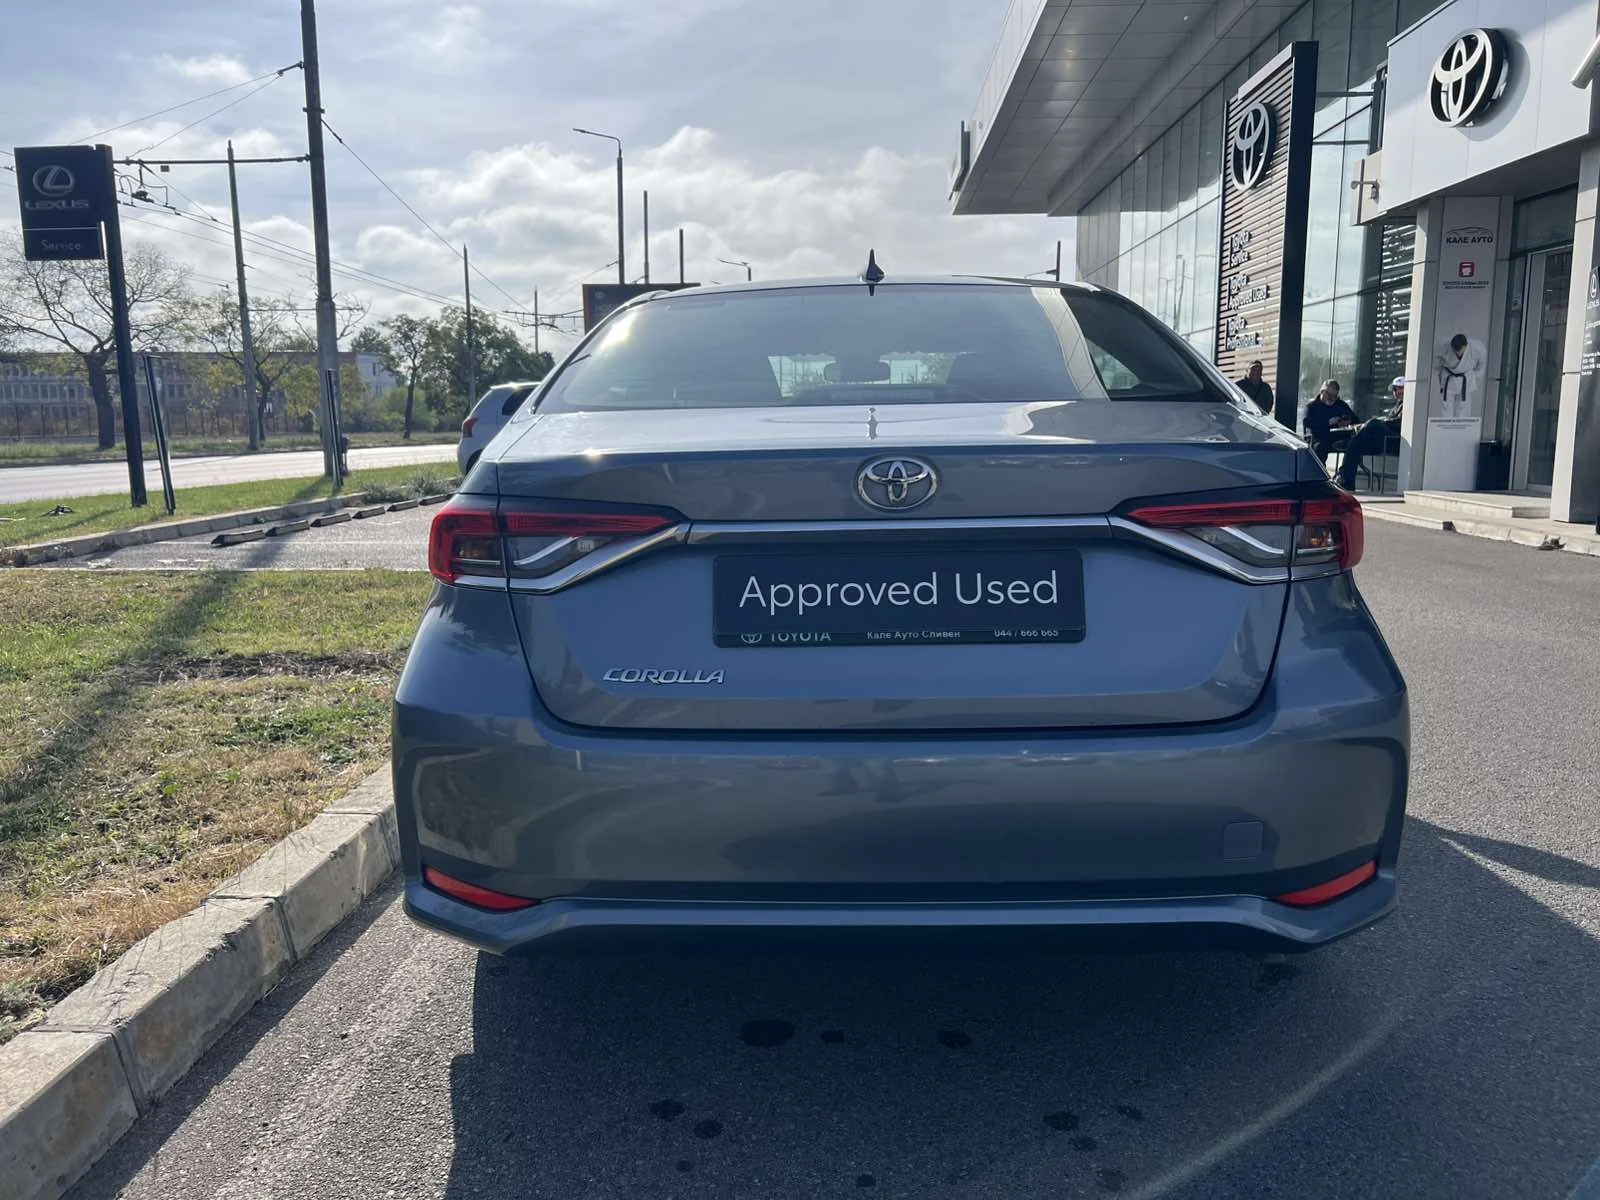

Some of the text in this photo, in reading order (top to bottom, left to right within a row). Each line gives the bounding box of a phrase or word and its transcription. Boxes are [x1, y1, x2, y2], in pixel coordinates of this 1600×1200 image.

[24, 199, 89, 210] LEXUS
[40, 239, 81, 251] Service
[1231, 231, 1250, 250] Toyota
[1446, 236, 1493, 244] КАЛЕ АУТО
[1231, 251, 1250, 267] Service
[1229, 275, 1248, 294] Toyota
[1227, 317, 1246, 334] Toyota
[738, 569, 1058, 616] Approved Used
[866, 630, 961, 641] Кале Ауто Сливен
[603, 667, 725, 685] COROLLA
